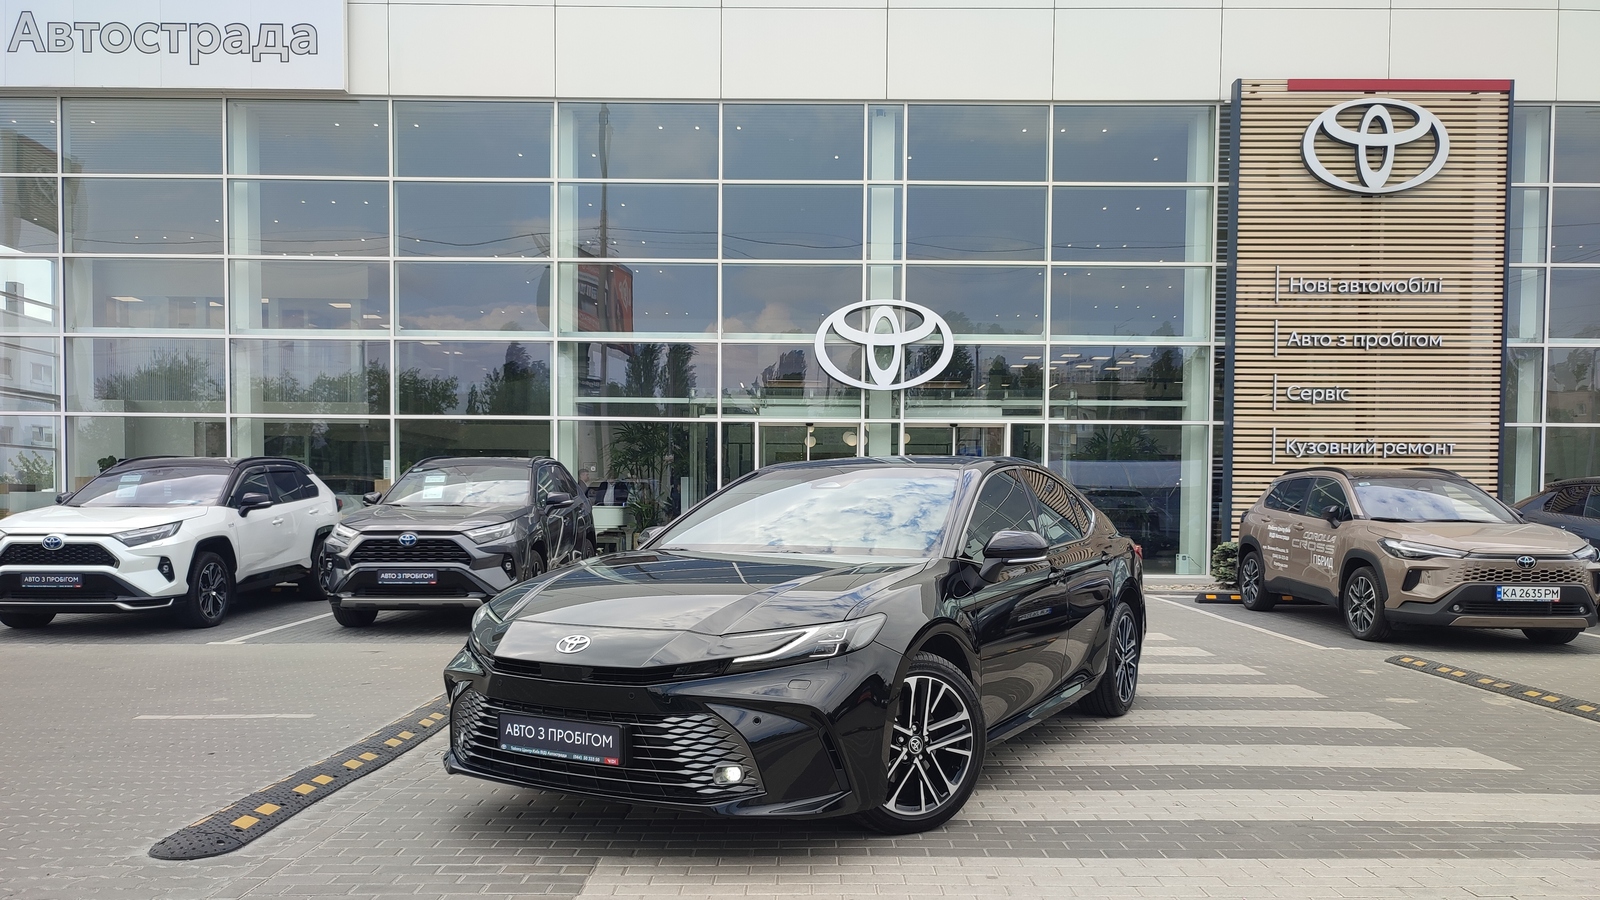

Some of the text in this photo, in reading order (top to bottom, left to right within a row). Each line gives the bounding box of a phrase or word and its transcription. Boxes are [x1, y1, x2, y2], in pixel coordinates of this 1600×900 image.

[6, 10, 319, 65] Автострада
[1288, 276, 1443, 293] Нові автомобілі
[1287, 330, 1443, 351] Авто з пробігом
[1285, 385, 1351, 405] Сервіс
[1285, 438, 1457, 458] Кузовний ремонт
[1291, 538, 1335, 555] CROSS
[1302, 531, 1337, 543] COROLLA
[1519, 588, 1543, 598] 2635
[505, 723, 535, 739] АВТО
[548, 728, 613, 749] ПРОБІГОМ
